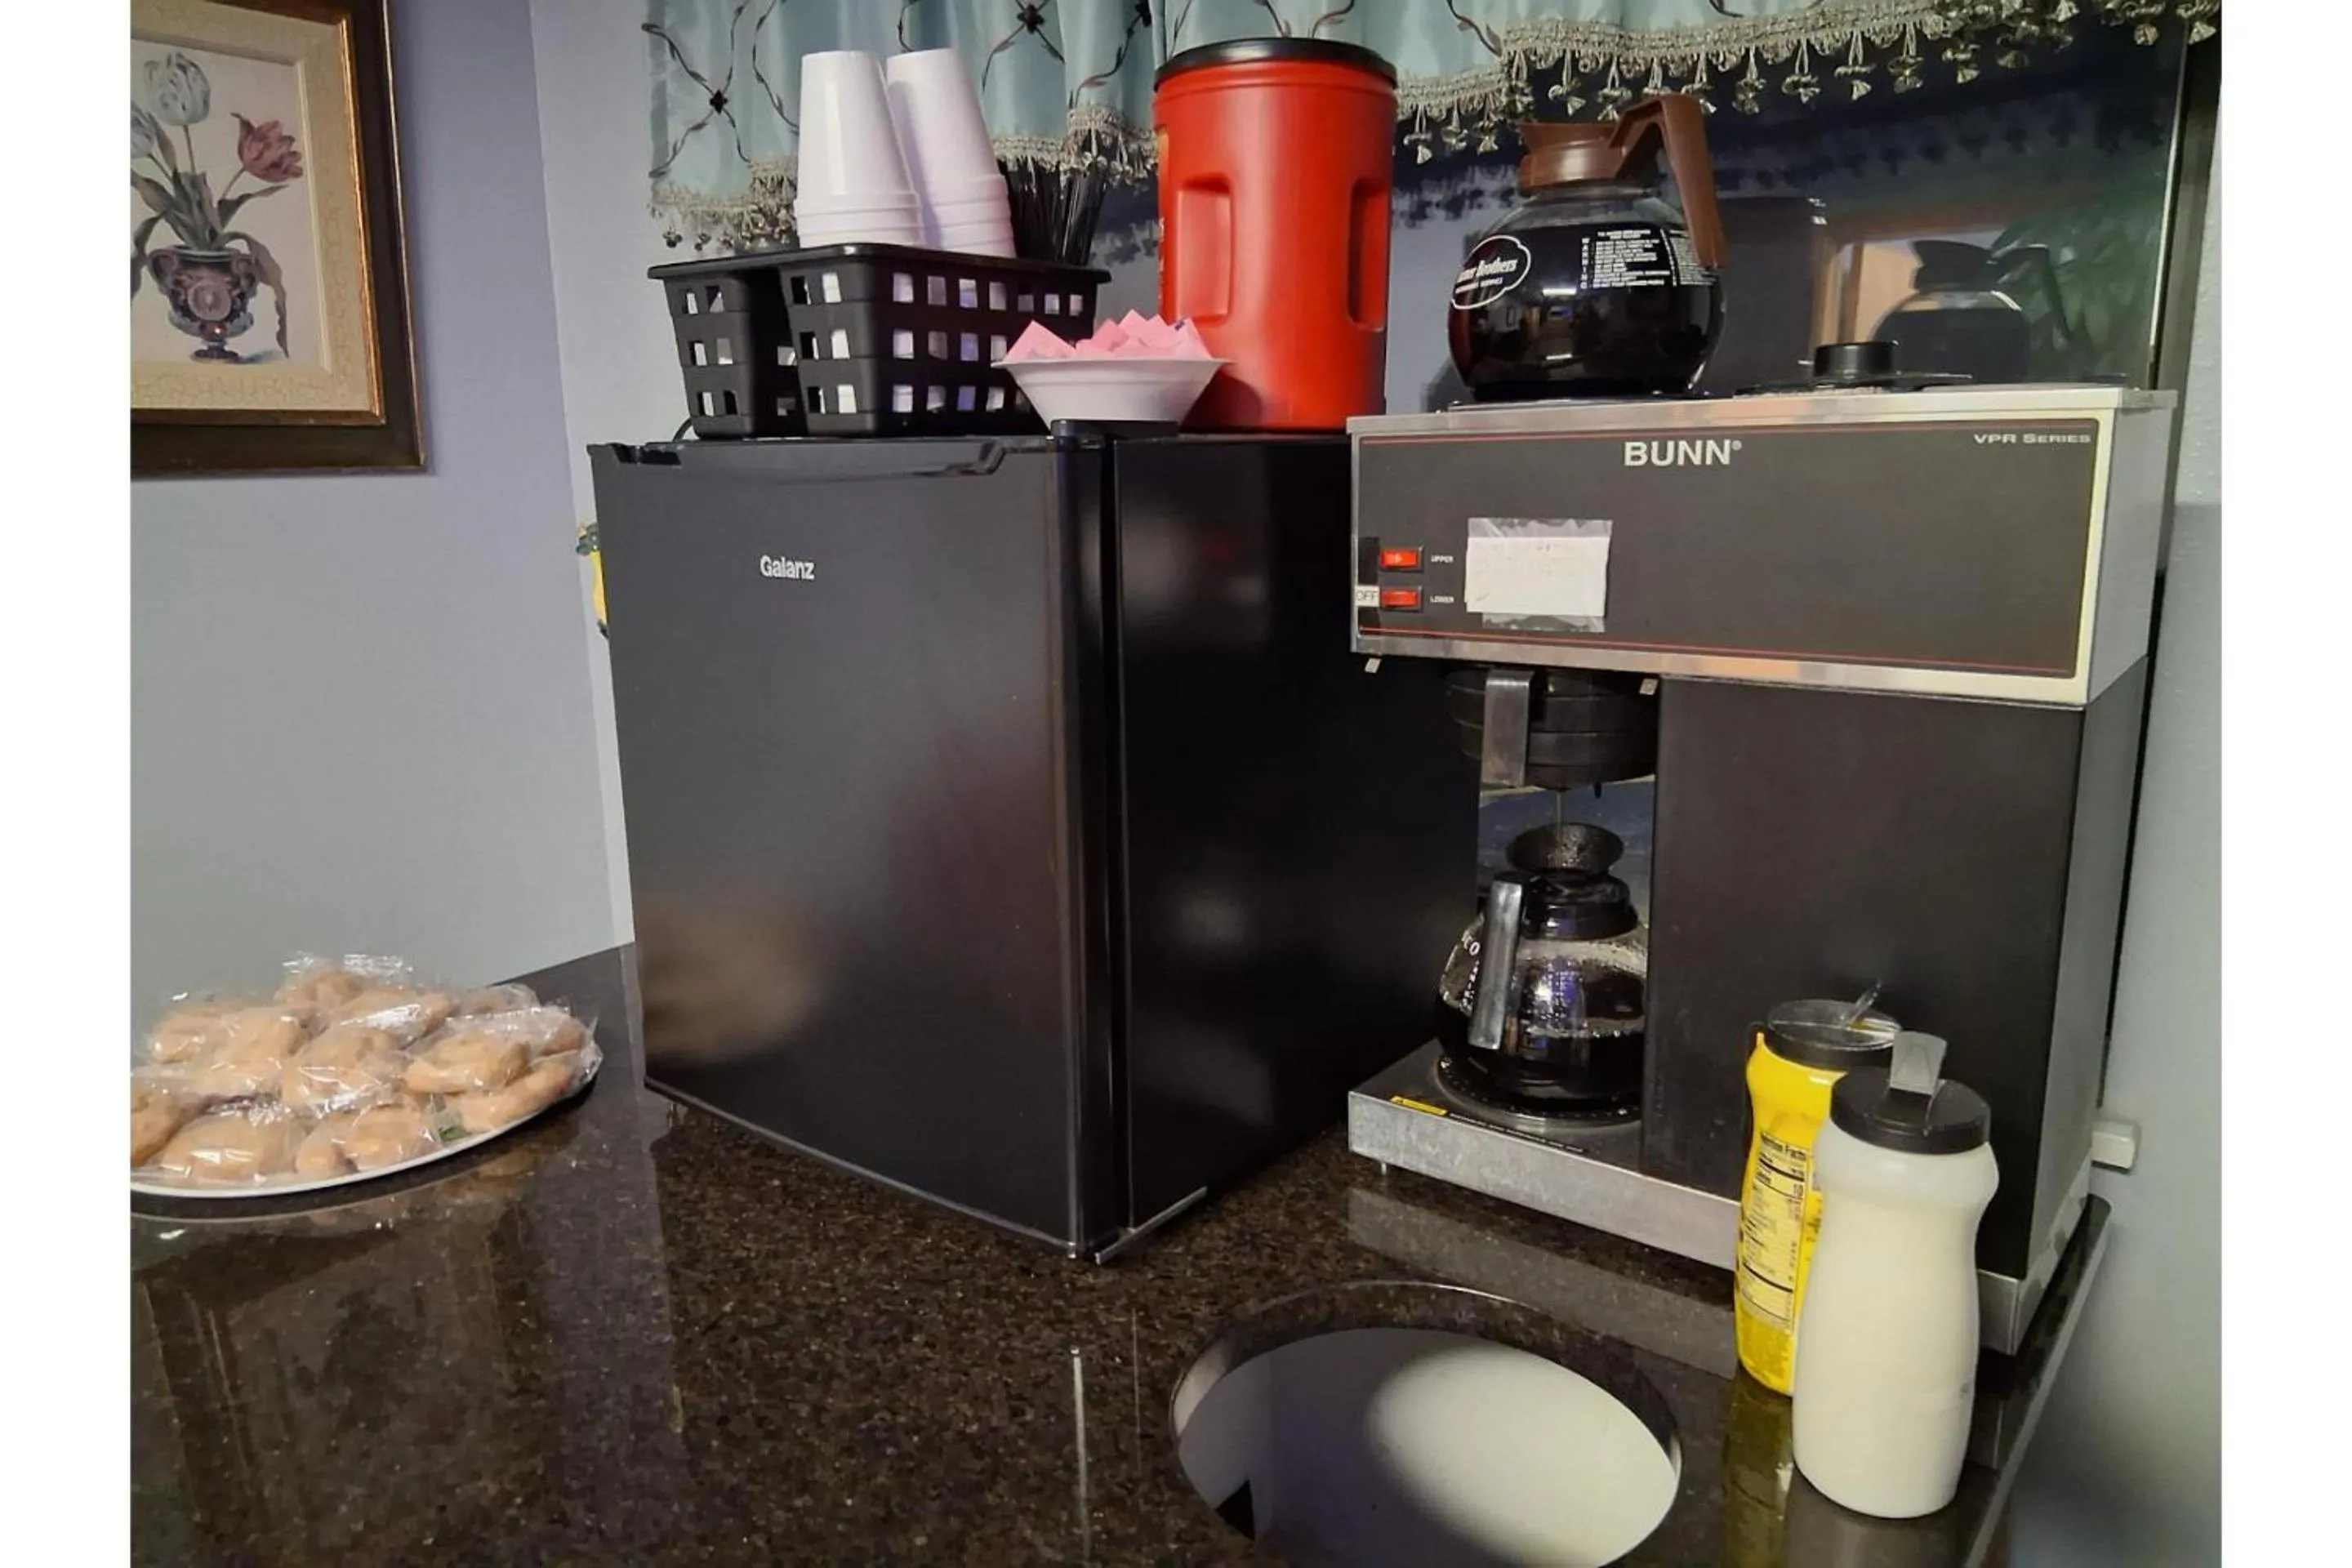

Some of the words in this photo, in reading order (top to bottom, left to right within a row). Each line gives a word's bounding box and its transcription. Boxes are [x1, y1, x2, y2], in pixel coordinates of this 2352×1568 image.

[1973, 433, 2017, 444] VPR
[1624, 439, 1731, 466] BUNN
[760, 555, 815, 580] Galanz
